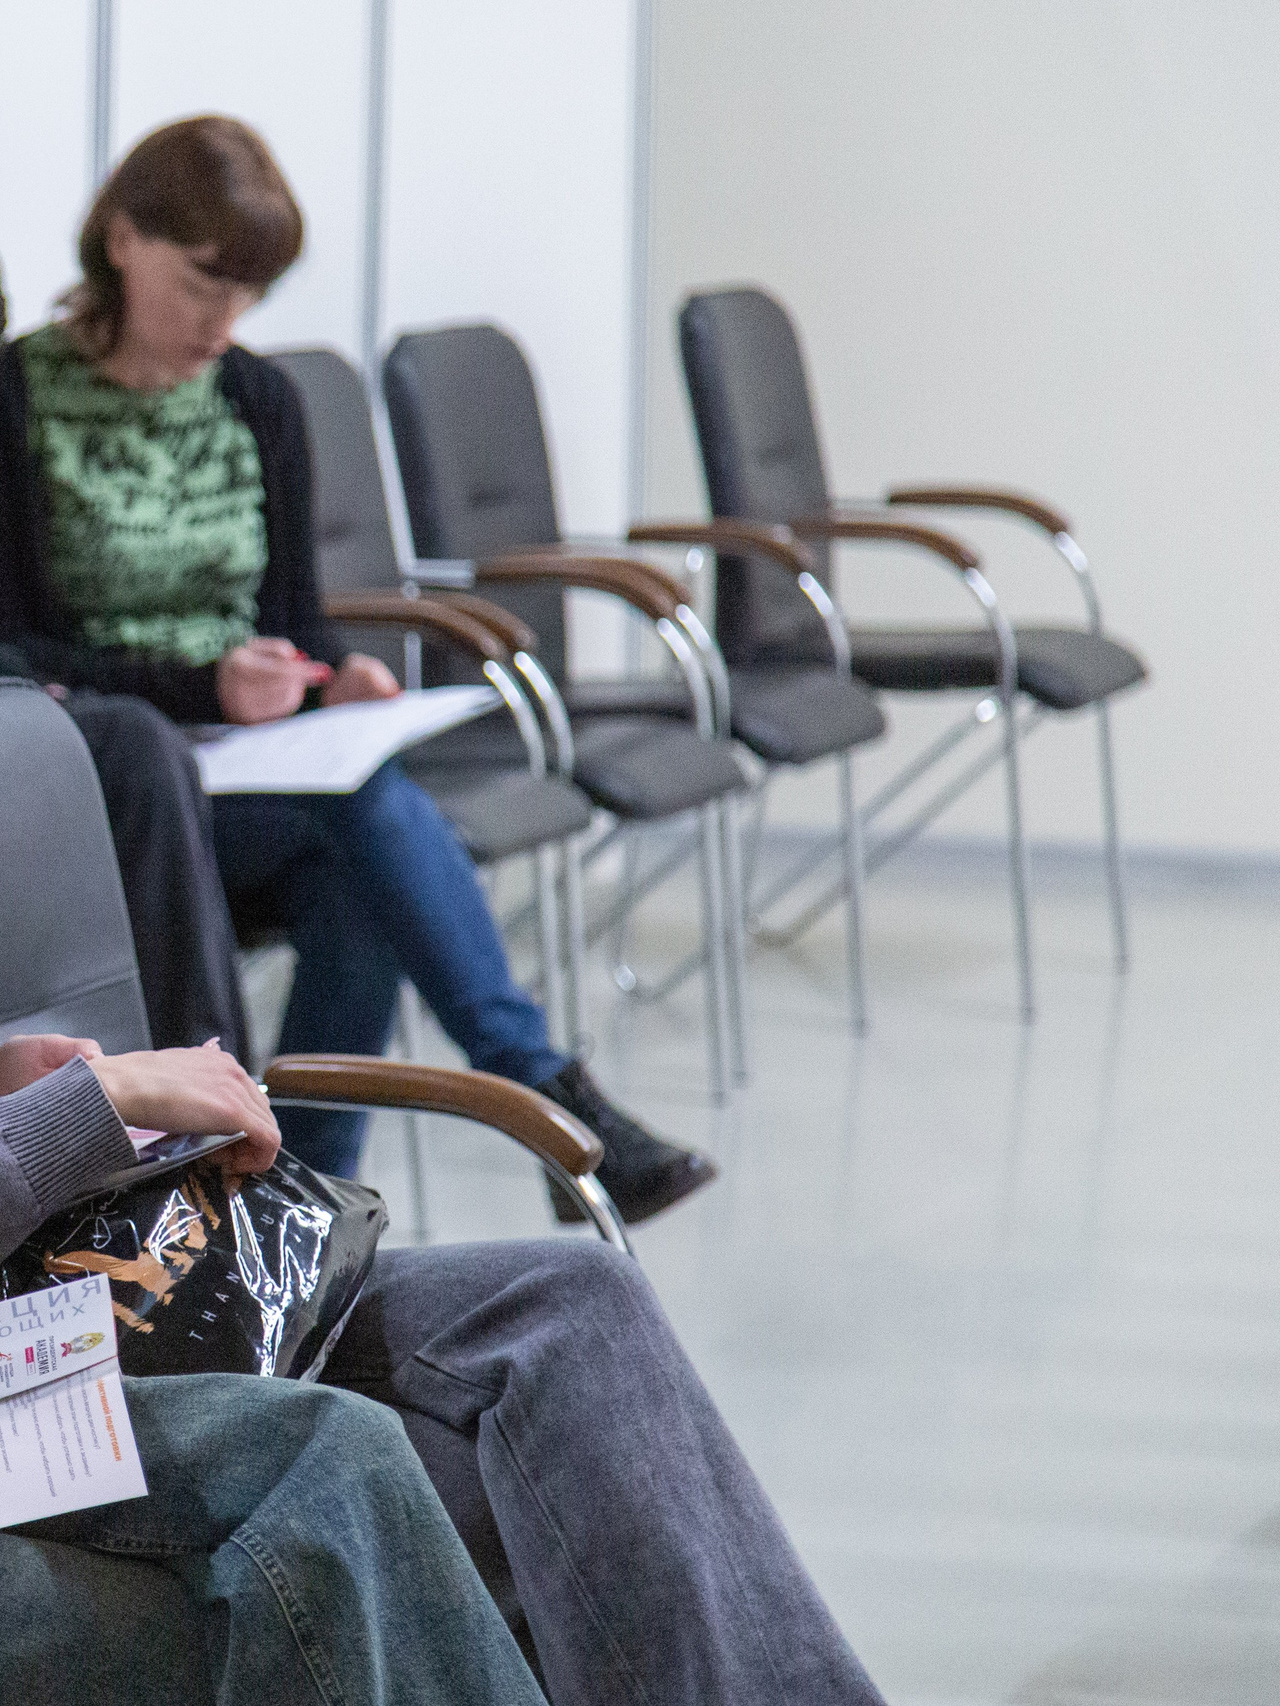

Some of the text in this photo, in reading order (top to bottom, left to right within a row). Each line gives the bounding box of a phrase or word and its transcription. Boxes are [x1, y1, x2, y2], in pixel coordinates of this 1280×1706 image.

[189, 1258, 249, 1342] THAN
[35, 1338, 49, 1376] АКАДЕМИЯ
[104, 1415, 122, 1462] подготовки
